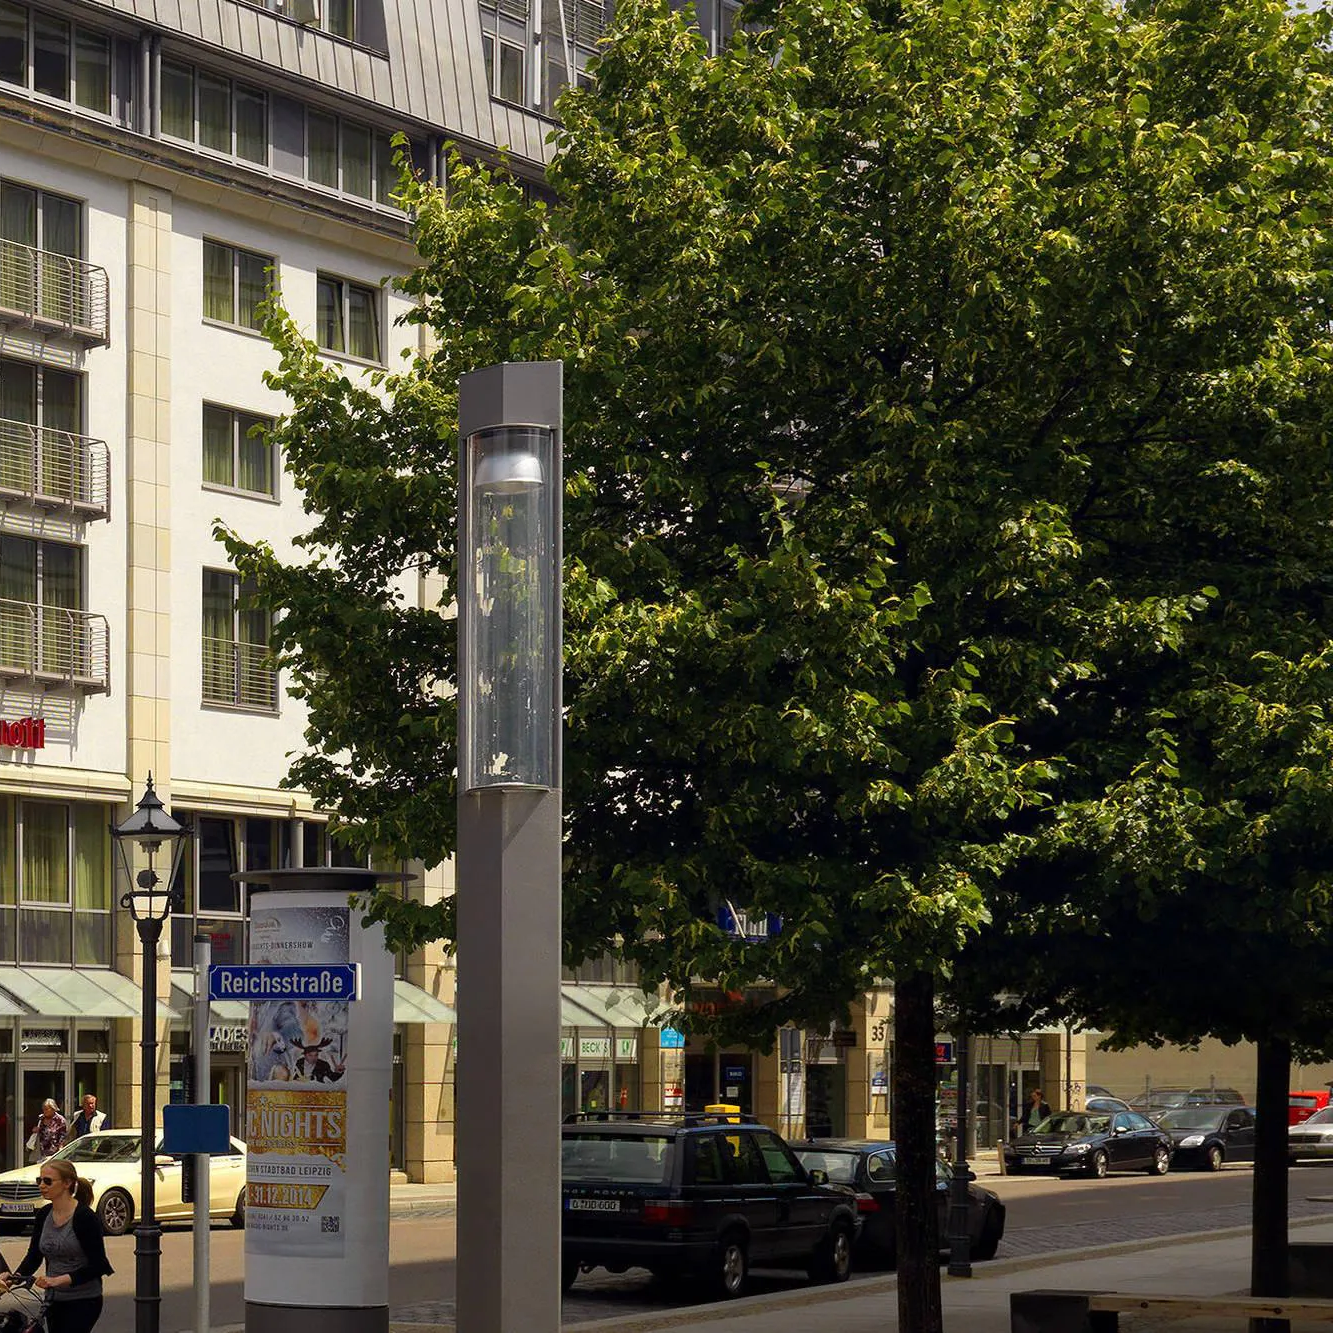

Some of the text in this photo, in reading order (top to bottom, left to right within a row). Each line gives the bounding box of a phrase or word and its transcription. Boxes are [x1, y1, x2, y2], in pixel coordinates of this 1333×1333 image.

[221, 971, 343, 993] Reichsstraße
[872, 1026, 884, 1041] 33
[261, 1110, 342, 1139] NIGHTS
[261, 1165, 296, 1175] STADTBAD
[299, 1166, 332, 1176] LEIPZIG
